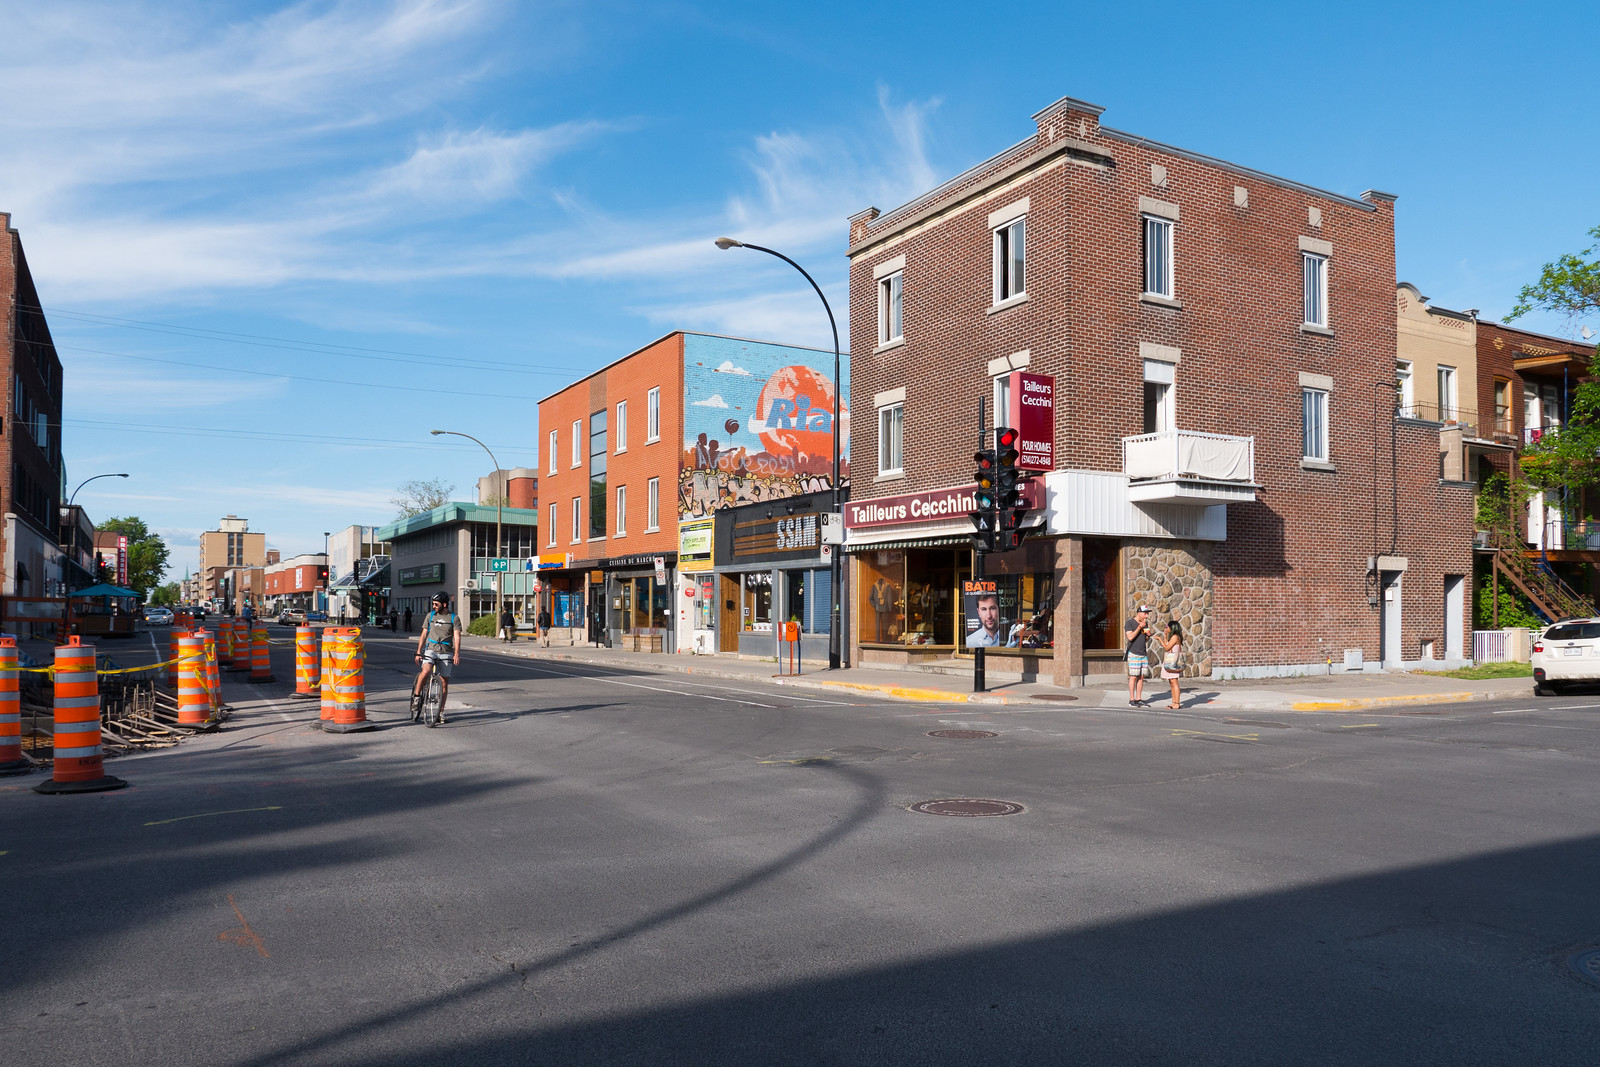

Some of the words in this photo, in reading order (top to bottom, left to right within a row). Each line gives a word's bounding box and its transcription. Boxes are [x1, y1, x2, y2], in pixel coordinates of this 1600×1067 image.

[1022, 380, 1052, 394] Tailleurs
[1022, 394, 1052, 408] Cecchini
[765, 393, 833, 434] Ria
[1022, 440, 1034, 451] POUR
[1034, 441, 1052, 453] HOMMES
[851, 504, 907, 523] Tailleurs
[910, 491, 977, 517] Cecchini
[776, 515, 817, 550] SSAM
